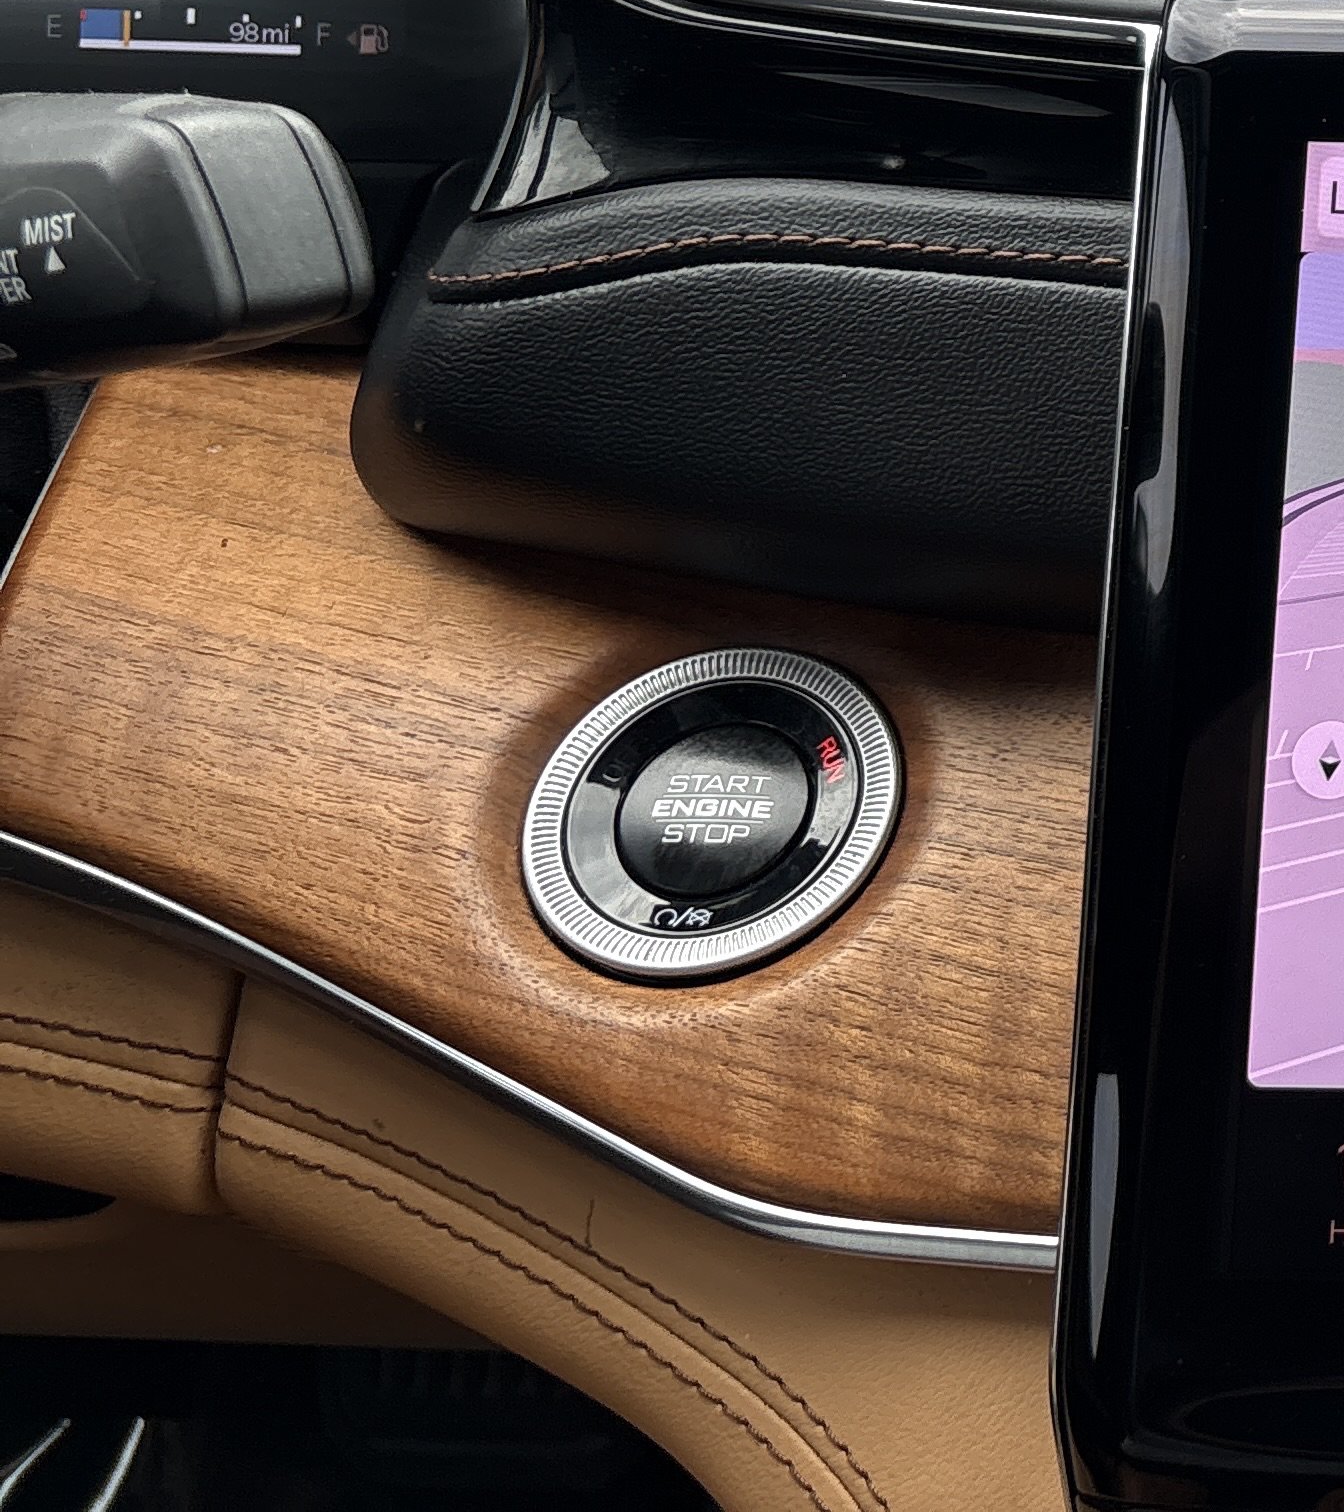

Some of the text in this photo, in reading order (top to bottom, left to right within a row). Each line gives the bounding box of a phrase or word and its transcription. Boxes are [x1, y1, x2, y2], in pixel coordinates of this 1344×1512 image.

[47, 14, 62, 39] E
[317, 23, 332, 46] F
[23, 212, 77, 246] MIST
[816, 736, 847, 783] RUN
[666, 774, 773, 794] START
[651, 798, 775, 820] ENGINE
[661, 823, 751, 844] STOP
